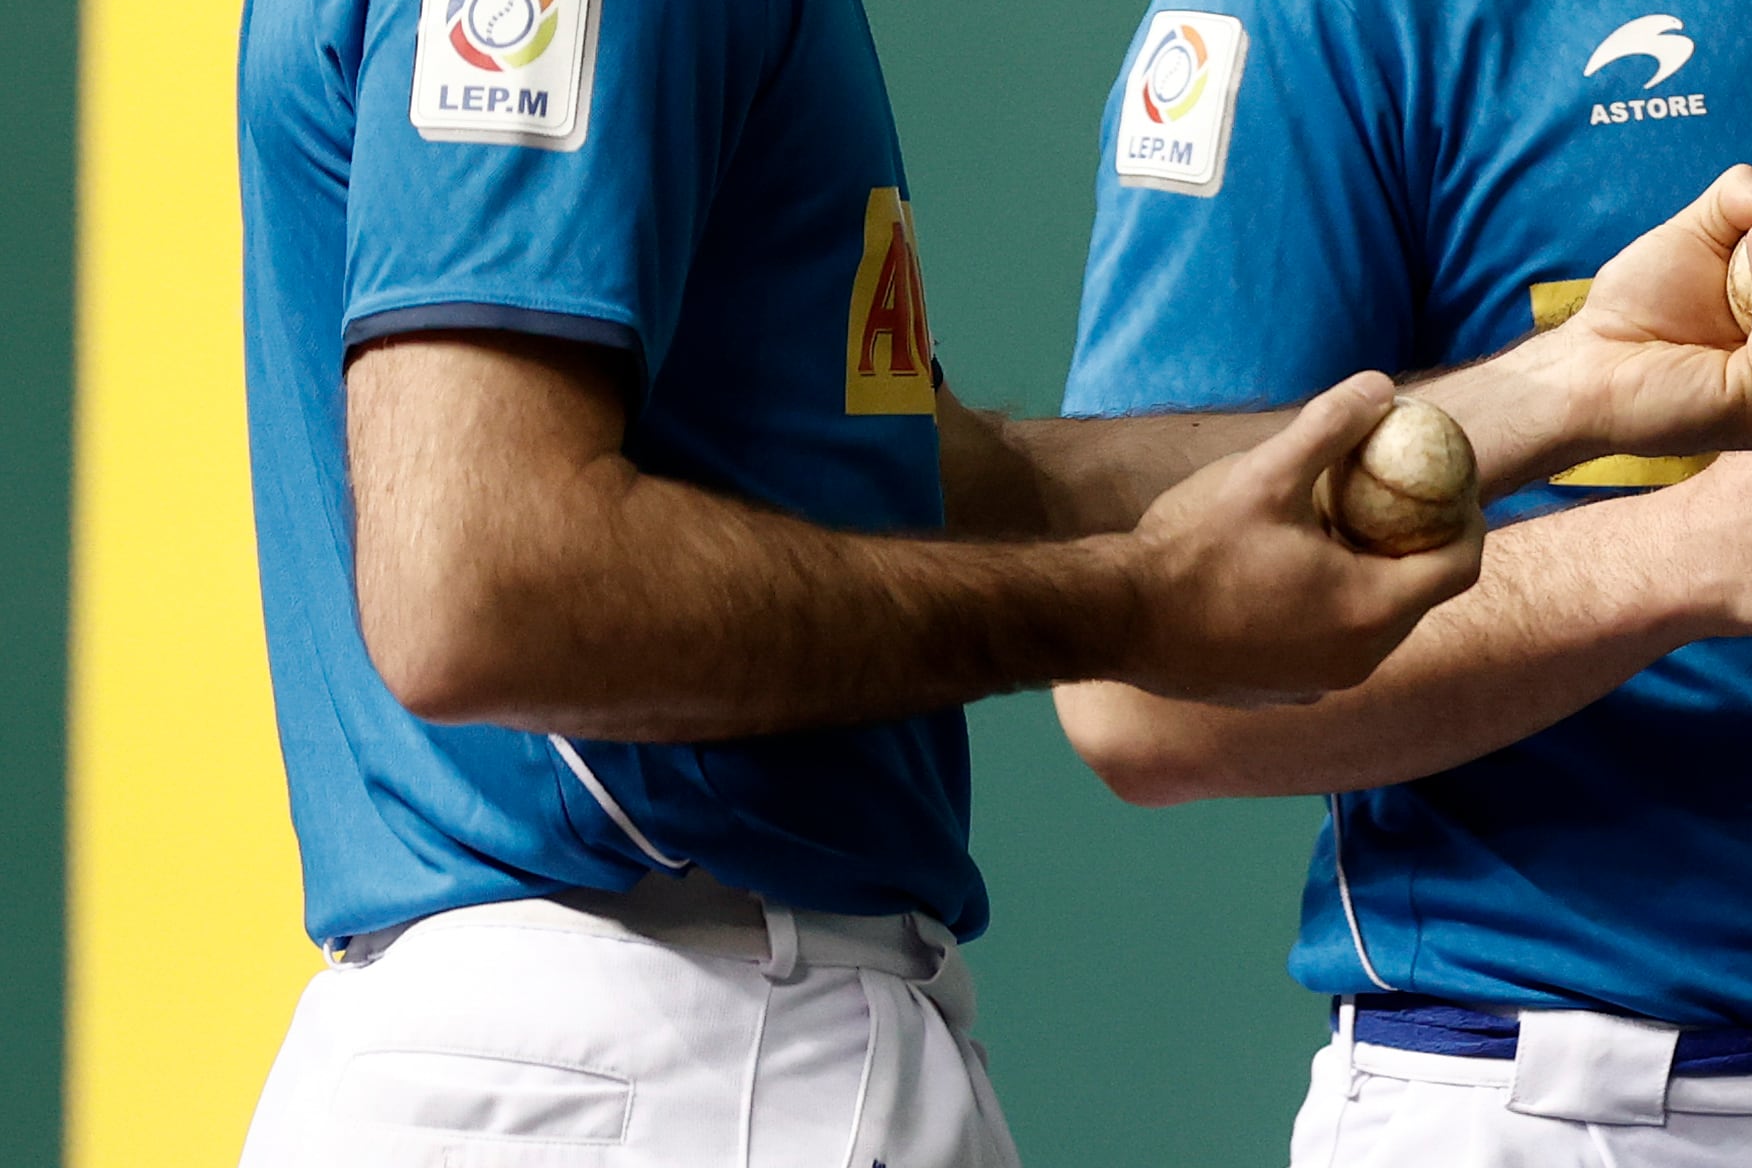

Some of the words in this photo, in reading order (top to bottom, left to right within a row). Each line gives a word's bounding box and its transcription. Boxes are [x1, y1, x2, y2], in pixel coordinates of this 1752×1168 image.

[438, 84, 549, 119] LEP.M
[1589, 93, 1708, 126] ASTORE
[1128, 135, 1194, 166] LEP.M
